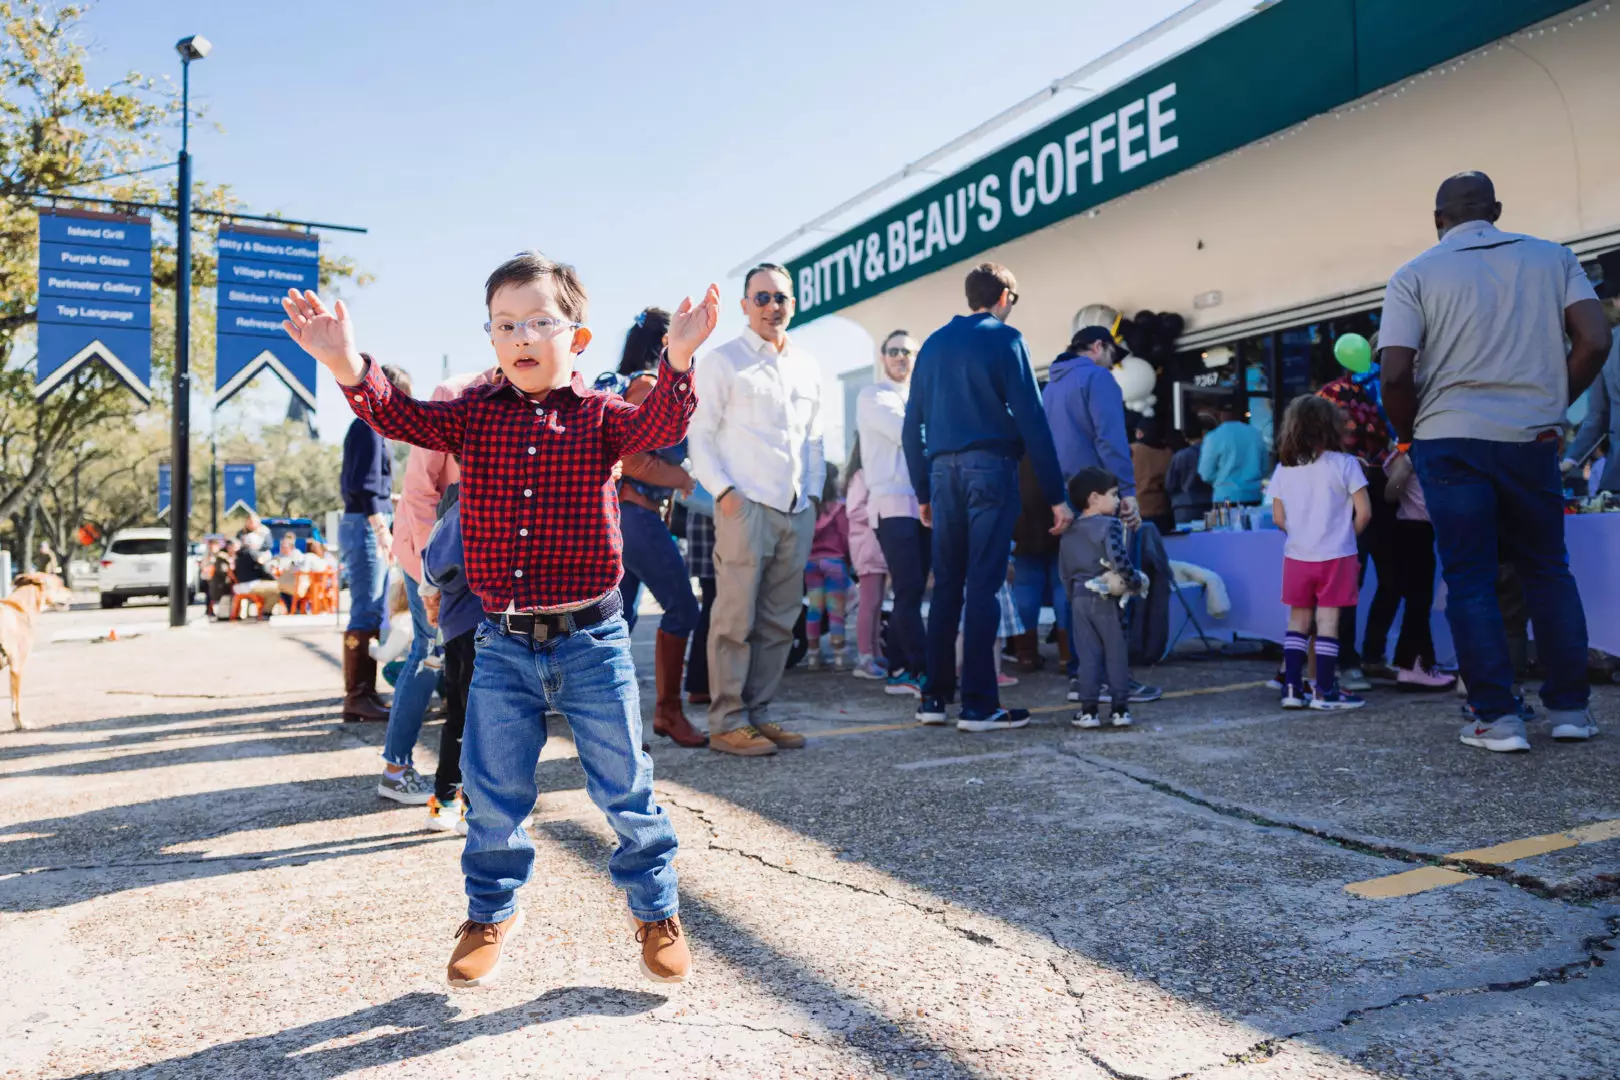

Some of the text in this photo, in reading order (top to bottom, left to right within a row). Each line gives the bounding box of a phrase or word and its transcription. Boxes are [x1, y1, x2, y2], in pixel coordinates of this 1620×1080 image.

[1010, 82, 1179, 217] COFFEE
[67, 226, 125, 240] Island Grill
[219, 238, 242, 252] Bitty
[243, 241, 251, 251] &
[285, 246, 317, 258] Coffee
[61, 252, 130, 267] Purple Glaze
[233, 265, 304, 281] Village Fitness
[48, 277, 142, 296] Perimeter Gallery
[56, 305, 134, 321] Top Language
